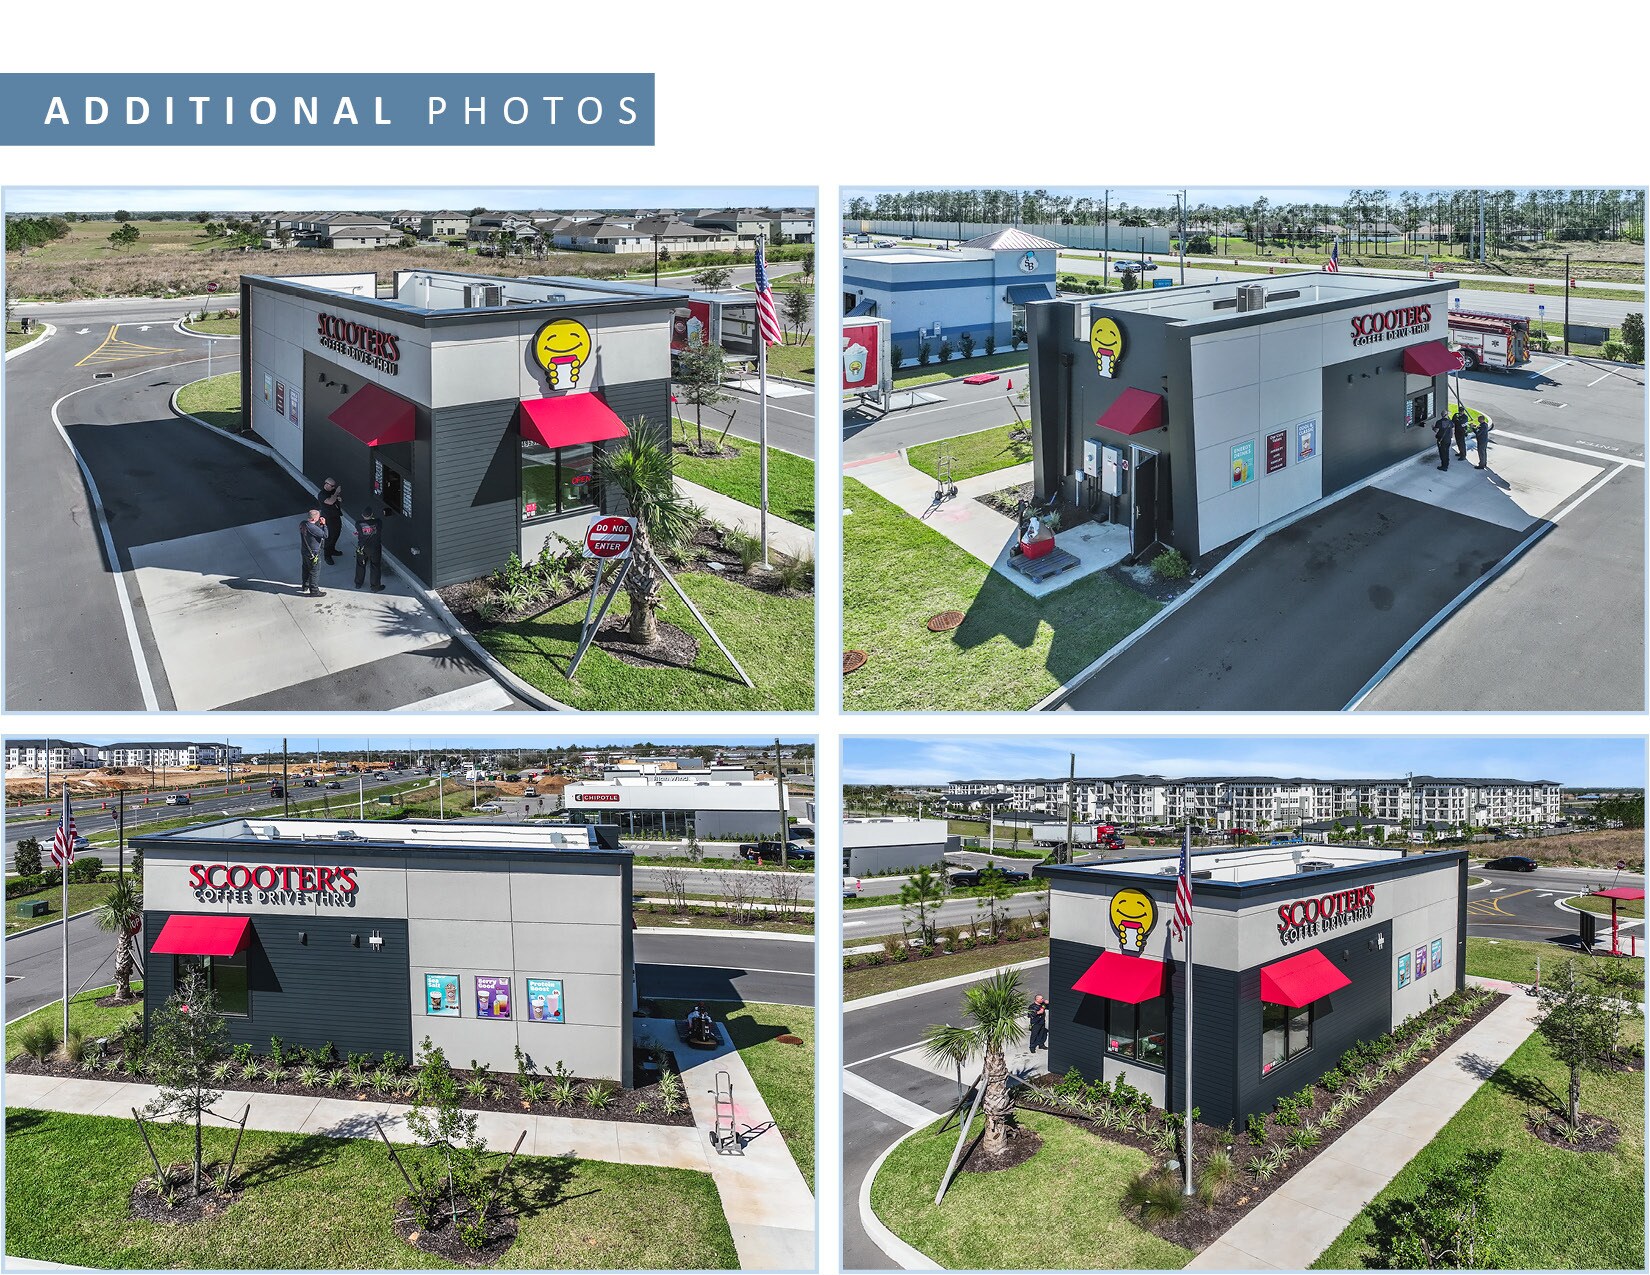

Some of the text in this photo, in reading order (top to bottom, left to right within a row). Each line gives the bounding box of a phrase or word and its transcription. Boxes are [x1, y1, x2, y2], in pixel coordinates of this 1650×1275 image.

[1350, 304, 1432, 338] SCOOTER'S
[318, 313, 399, 362] SCOOTER'S
[320, 336, 398, 376] COFFEE DRIVE-THRU
[1233, 444, 1251, 453] ENERGY
[1233, 449, 1251, 459] DRINKS
[571, 475, 591, 485] OPEN
[596, 524, 608, 532] DO
[594, 542, 621, 550] ENTER
[189, 864, 358, 893] SCOOTER'S
[193, 889, 353, 905] COFFEE DRIVE-THRU
[1278, 885, 1376, 932] SCOOTER'S
[1283, 907, 1373, 943] COFFEE DRIVE-THRU
